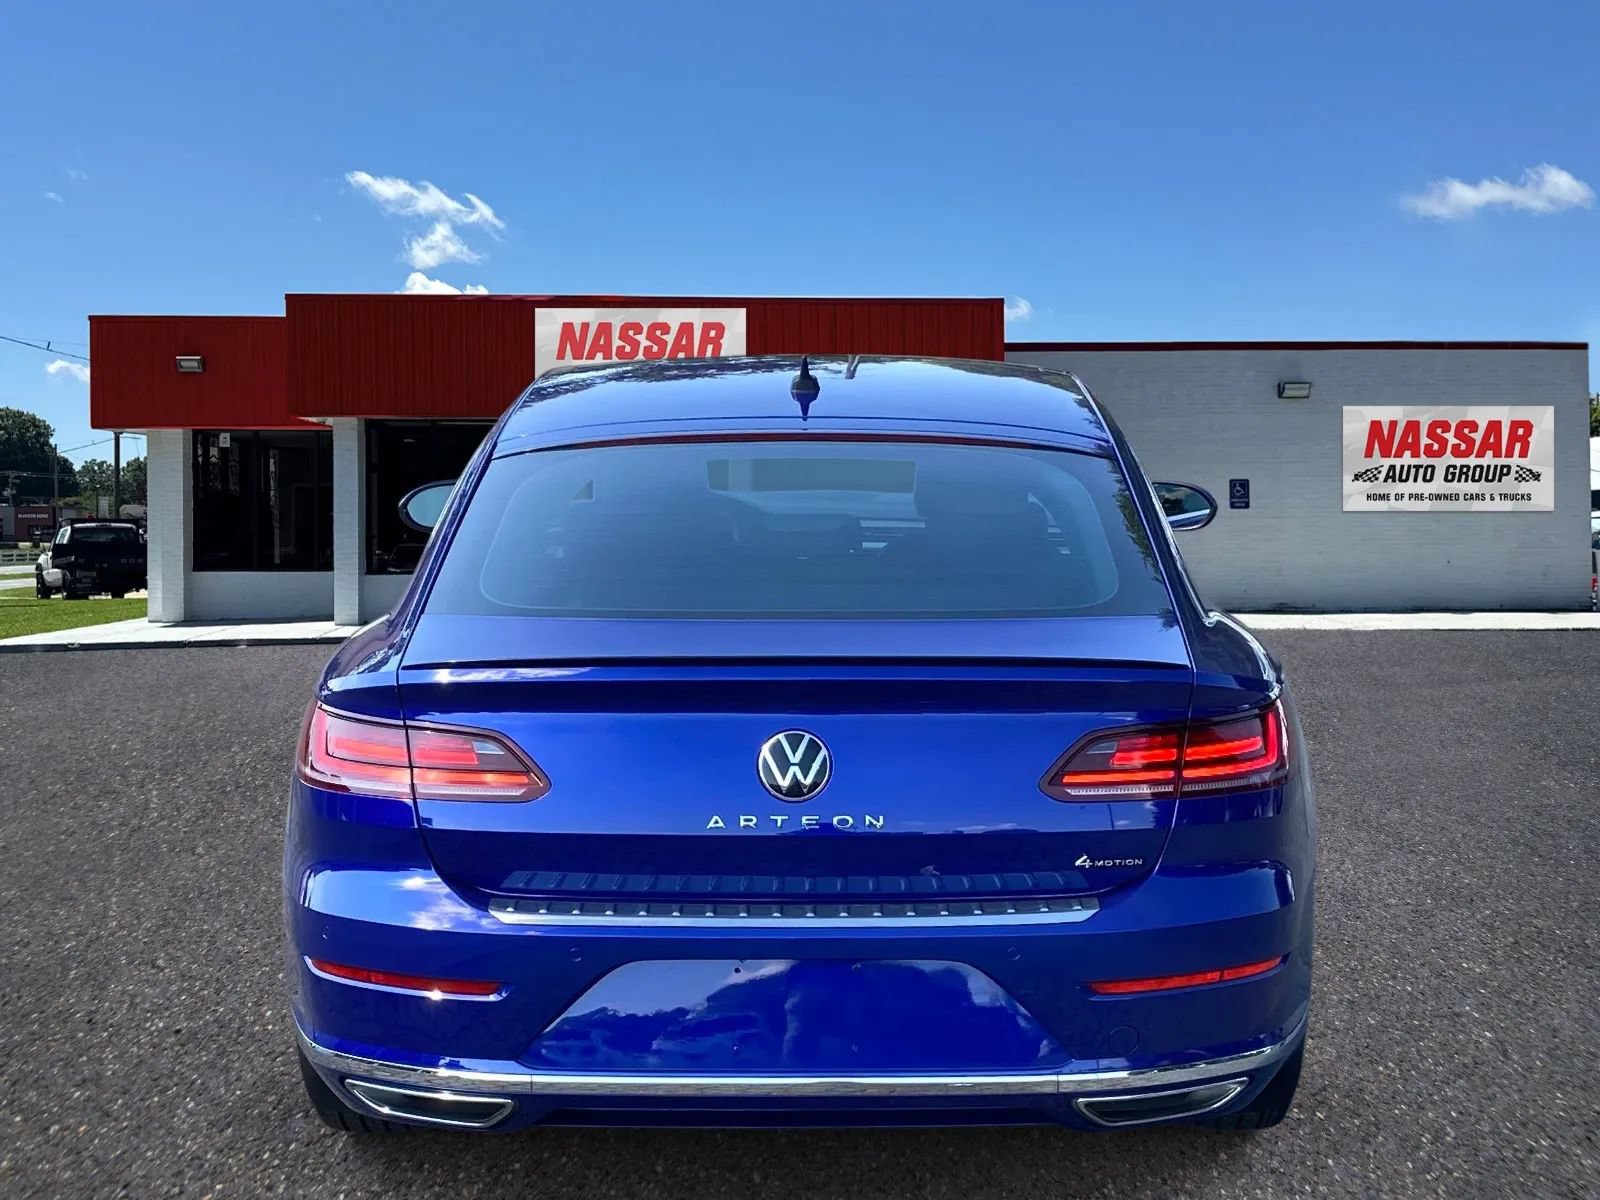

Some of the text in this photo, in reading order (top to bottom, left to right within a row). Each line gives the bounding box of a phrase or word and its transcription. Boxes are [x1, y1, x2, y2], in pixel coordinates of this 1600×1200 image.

[556, 322, 725, 360] NASSAR
[1364, 420, 1534, 458] NASSAR
[1383, 464, 1511, 483] AUTO GROUP
[1366, 493, 1532, 502] HOME OF PRE-OWNED CARS & TRUCKS
[706, 815, 884, 829] ARTEON
[1074, 854, 1143, 869] 4MOTION
